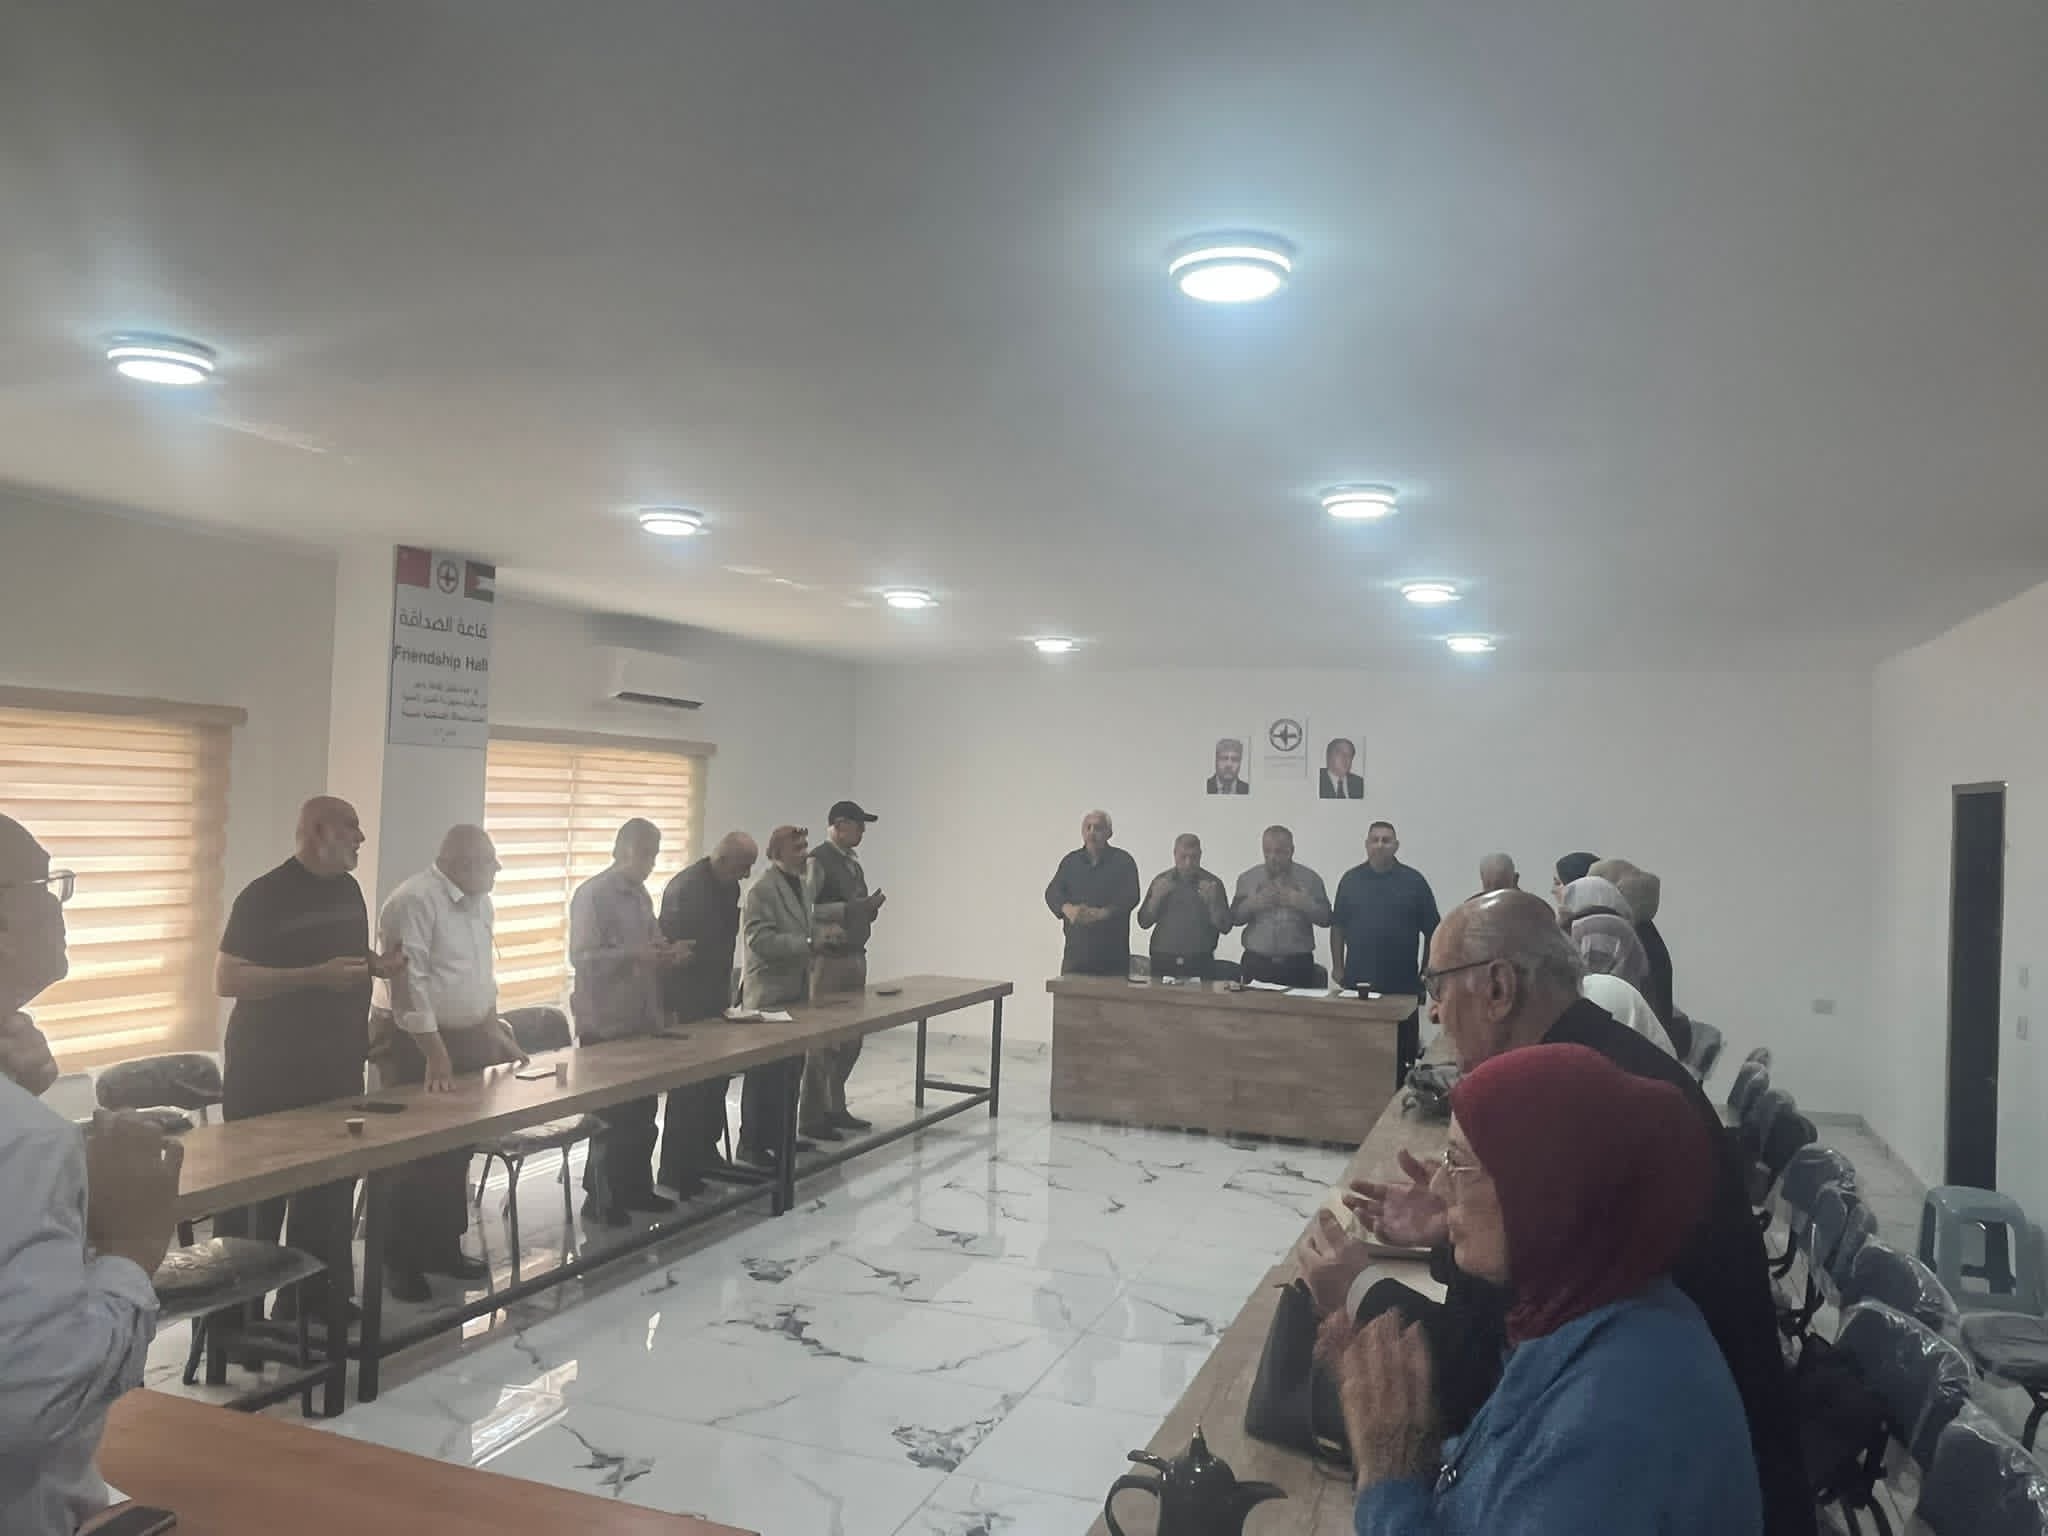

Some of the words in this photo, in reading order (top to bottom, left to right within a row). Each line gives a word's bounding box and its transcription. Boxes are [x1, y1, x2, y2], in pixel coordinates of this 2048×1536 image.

[399, 607, 454, 632] الصداقة
[457, 618, 488, 639] قاعة
[394, 645, 462, 671] Friendship
[465, 656, 489, 671] Hall
